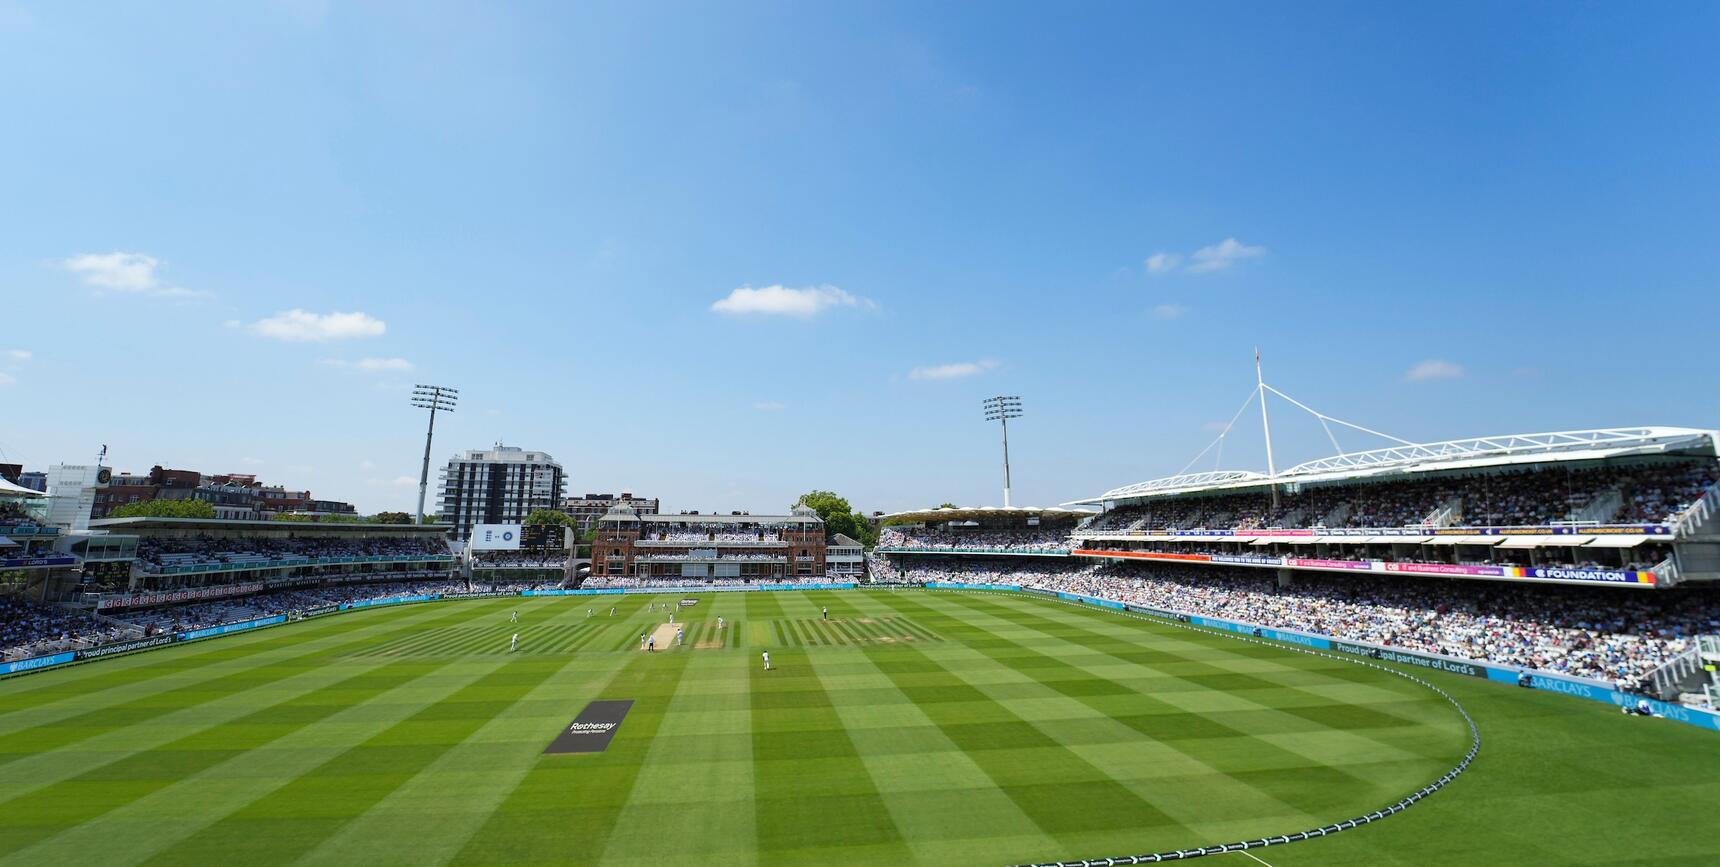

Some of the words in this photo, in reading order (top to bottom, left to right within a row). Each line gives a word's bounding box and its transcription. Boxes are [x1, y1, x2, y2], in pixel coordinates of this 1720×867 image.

[1440, 565, 1468, 574] Consulting
[1547, 570, 1626, 581] FOUNDATION
[1282, 633, 1312, 646] BARCLAYS
[84, 648, 101, 657] roud
[101, 643, 127, 655] principal
[128, 638, 149, 650] partner
[149, 637, 156, 645] of
[18, 656, 55, 670] BARCLAYS
[1337, 643, 1360, 654] Proud
[1361, 648, 1396, 660] priipal
[1397, 655, 1430, 667] partner
[1432, 659, 1442, 668] of
[1443, 662, 1476, 675] Lord's
[570, 722, 617, 731] Rothesay
